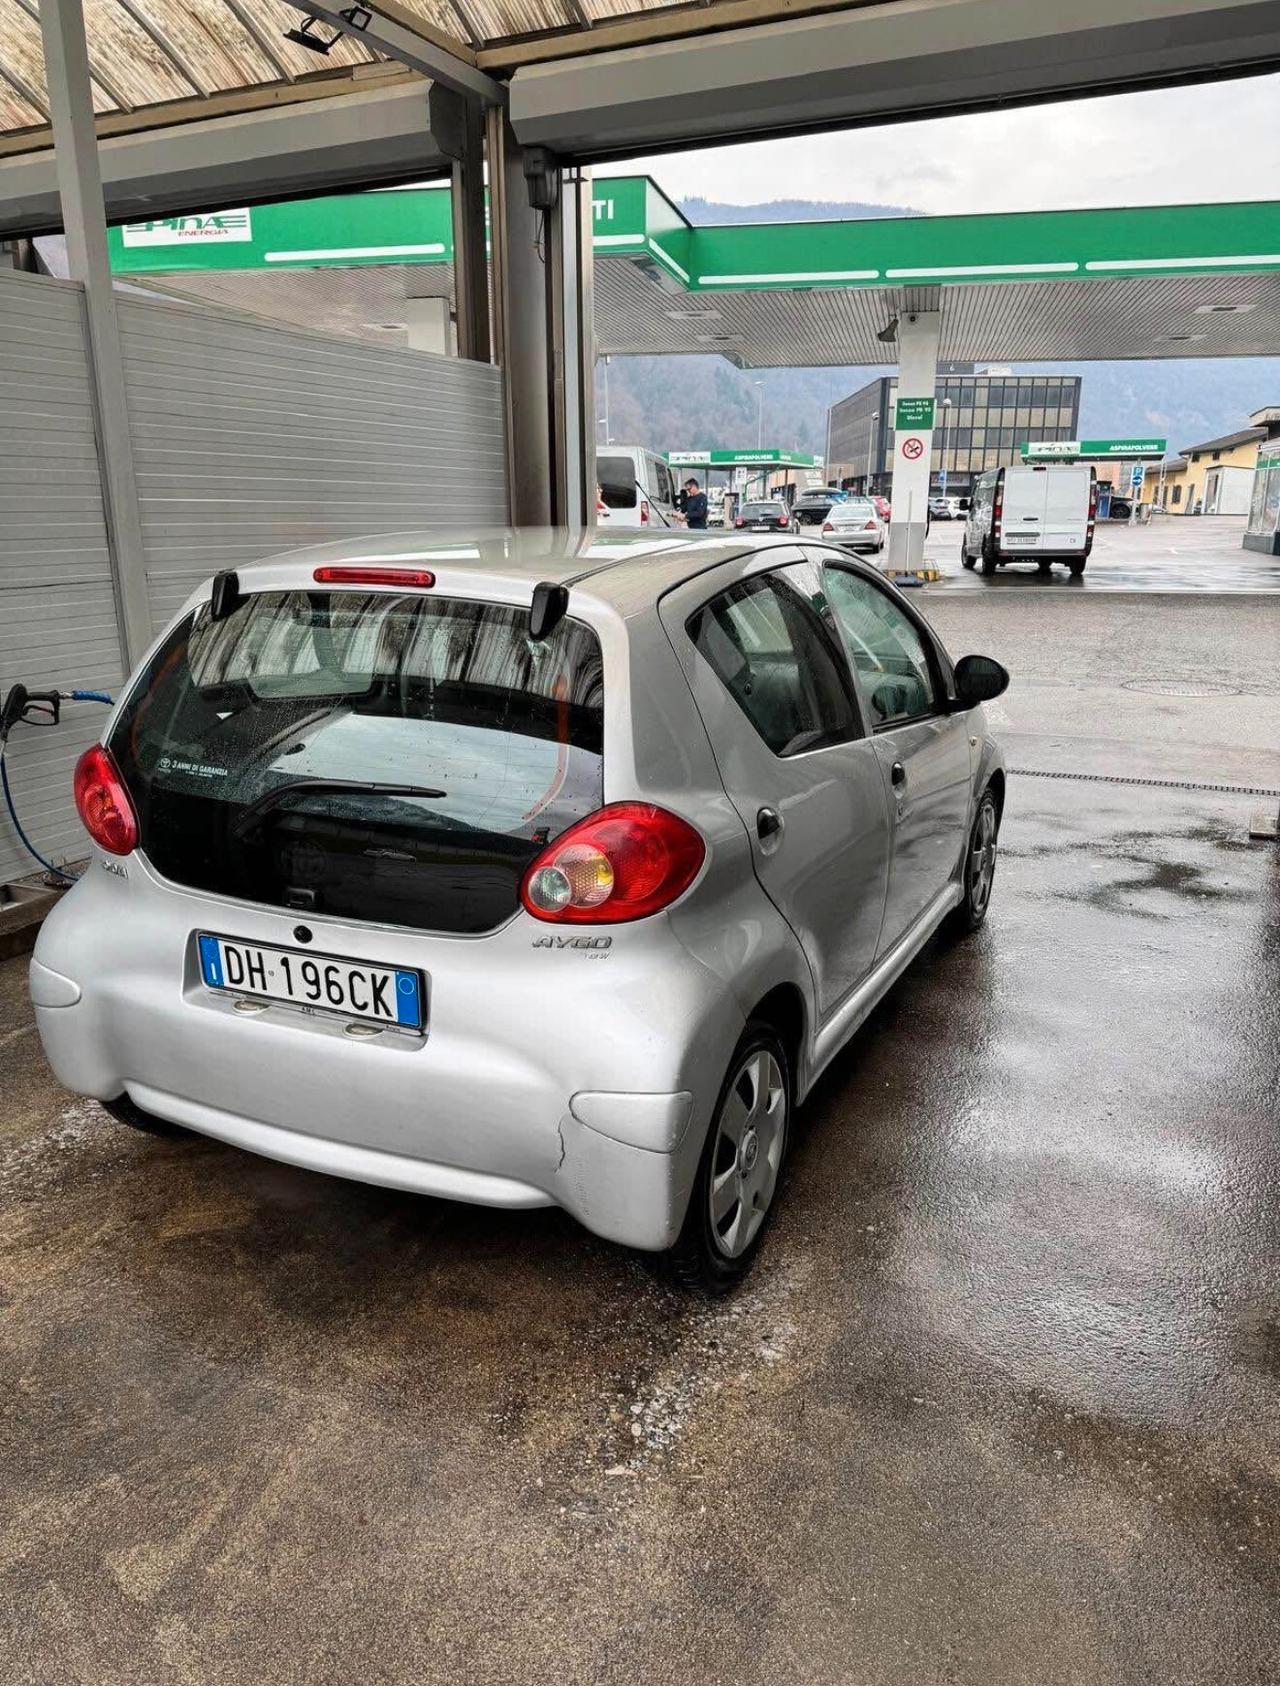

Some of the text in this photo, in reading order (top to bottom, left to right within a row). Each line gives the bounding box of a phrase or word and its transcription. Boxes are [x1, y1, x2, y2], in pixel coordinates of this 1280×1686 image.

[532, 936, 613, 949] AYGO
[223, 945, 393, 1018] DH 196CK
